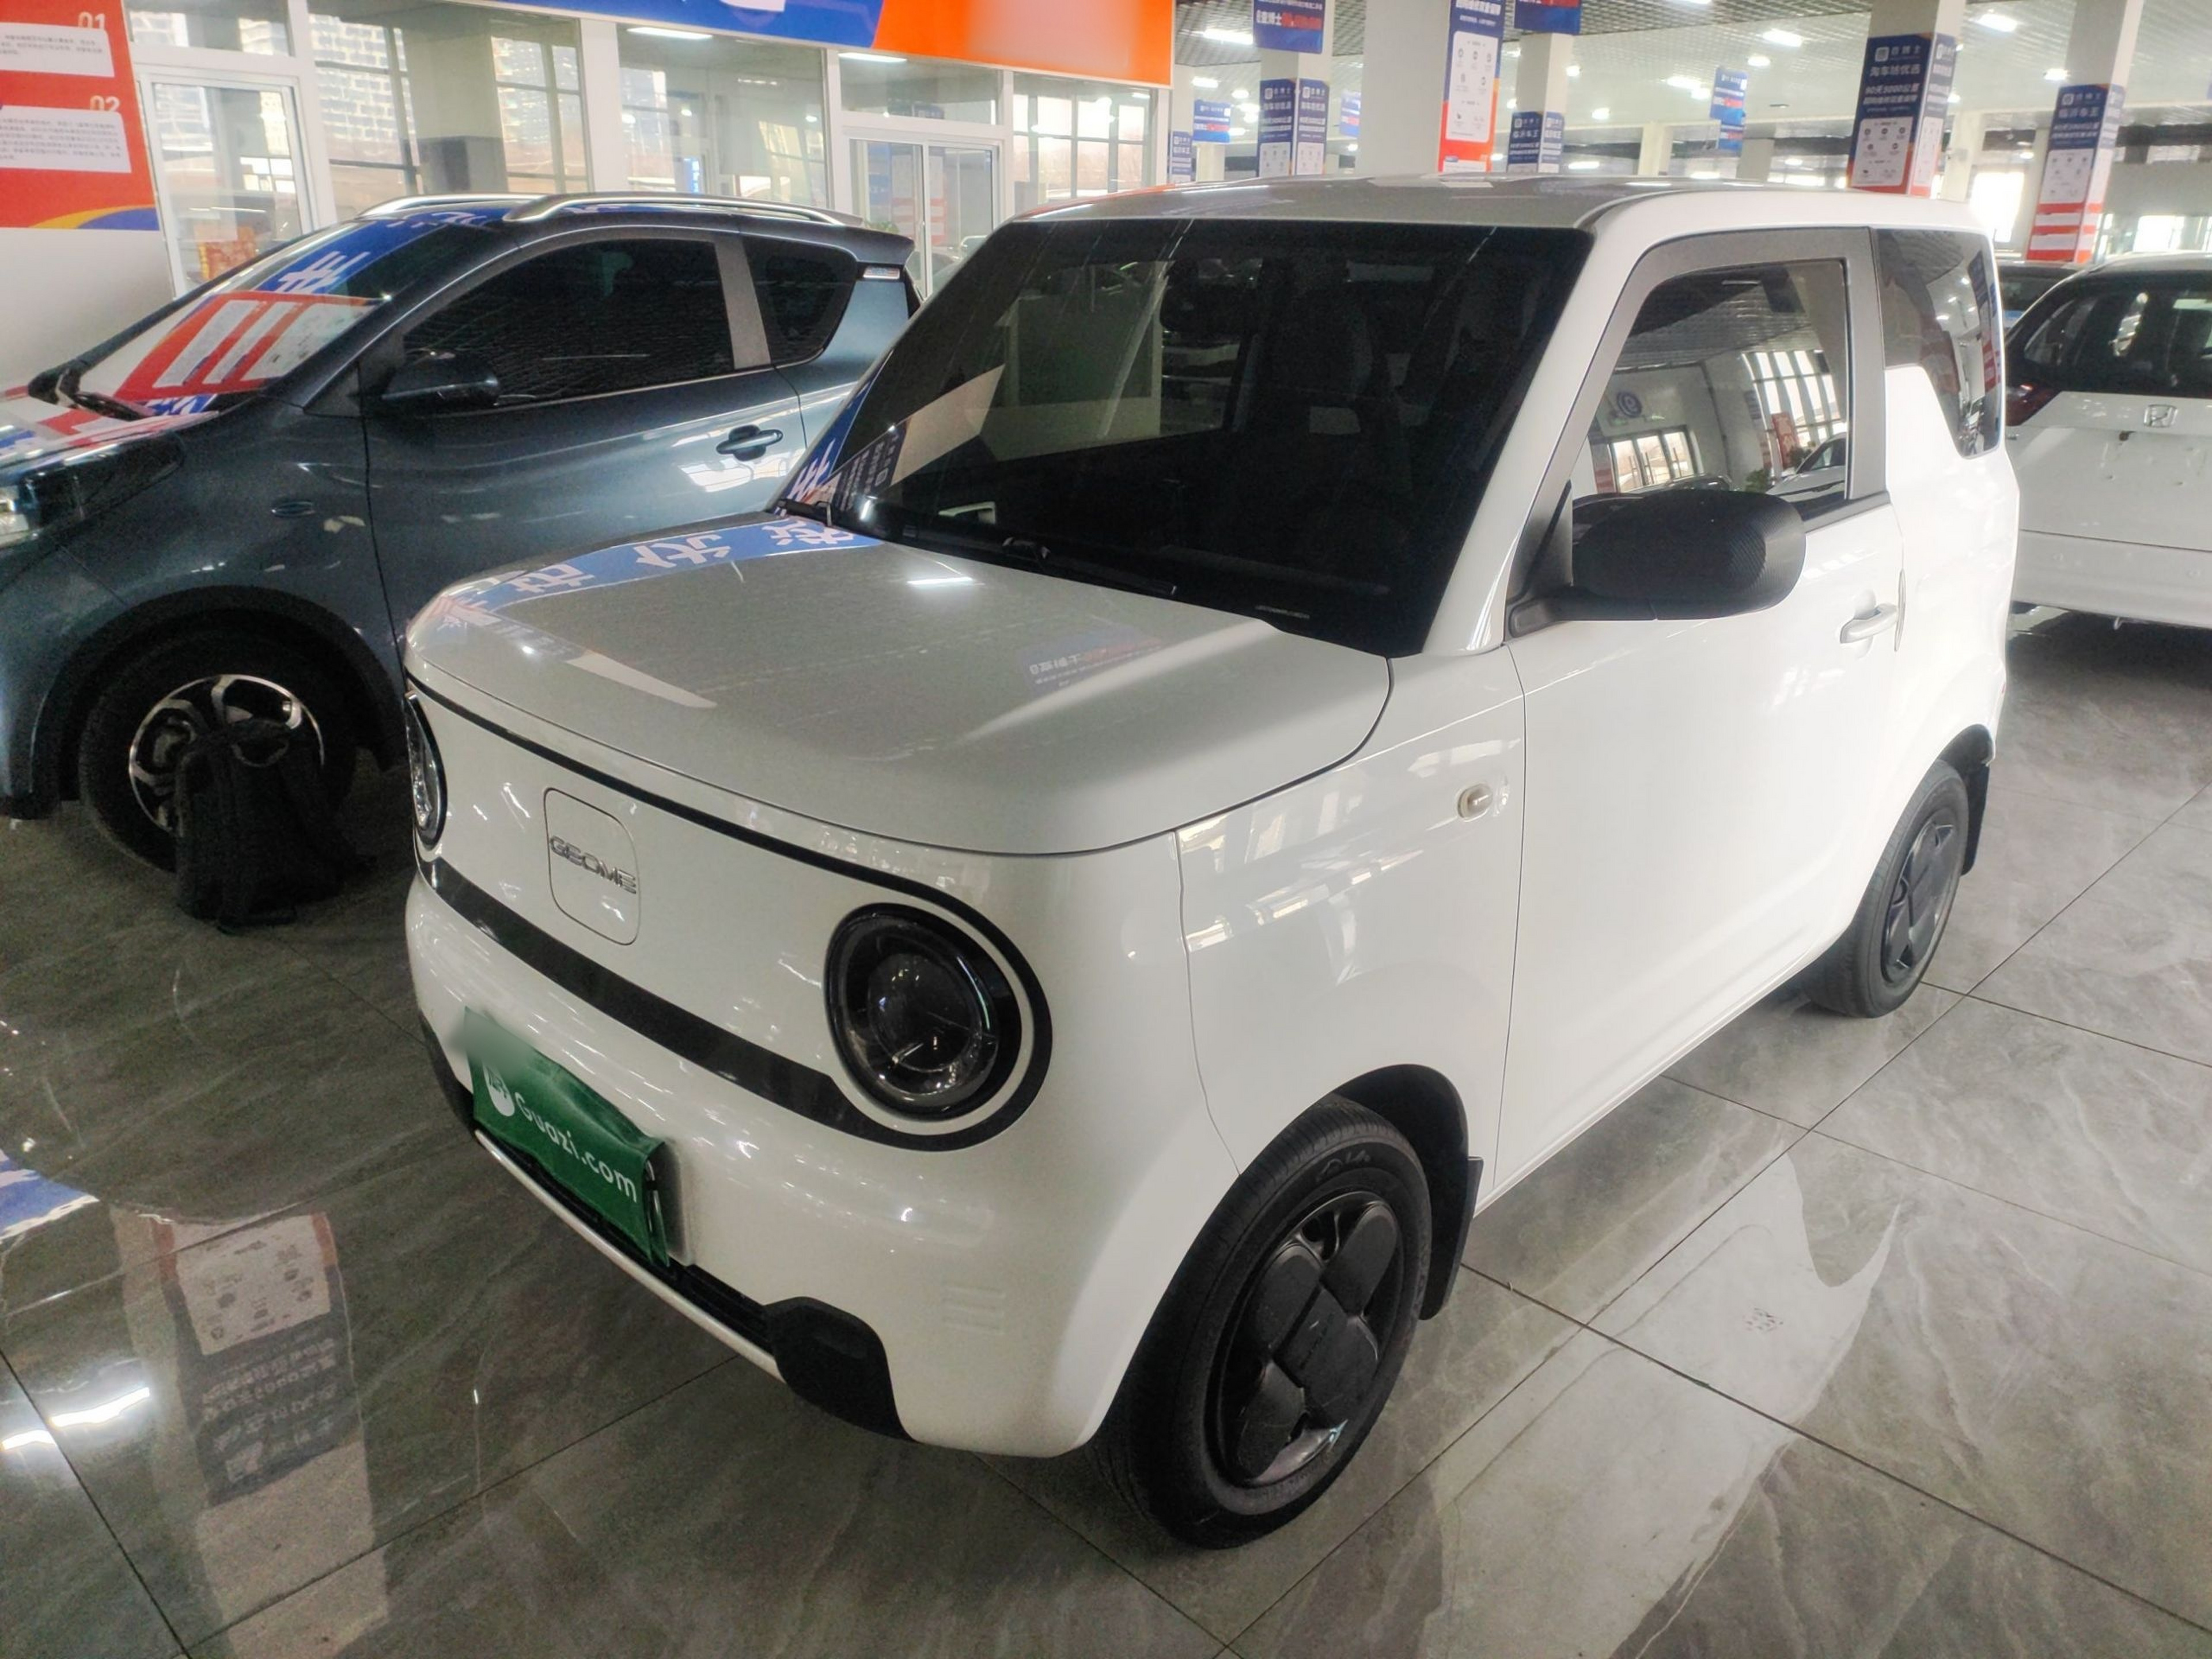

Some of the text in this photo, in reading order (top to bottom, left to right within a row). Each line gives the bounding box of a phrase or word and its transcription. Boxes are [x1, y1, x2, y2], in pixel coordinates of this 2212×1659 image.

[78, 12, 106, 29] 01
[90, 95, 120, 112] 02
[550, 835, 637, 894] GEOME
[514, 1092, 638, 1203] Guazi.com
